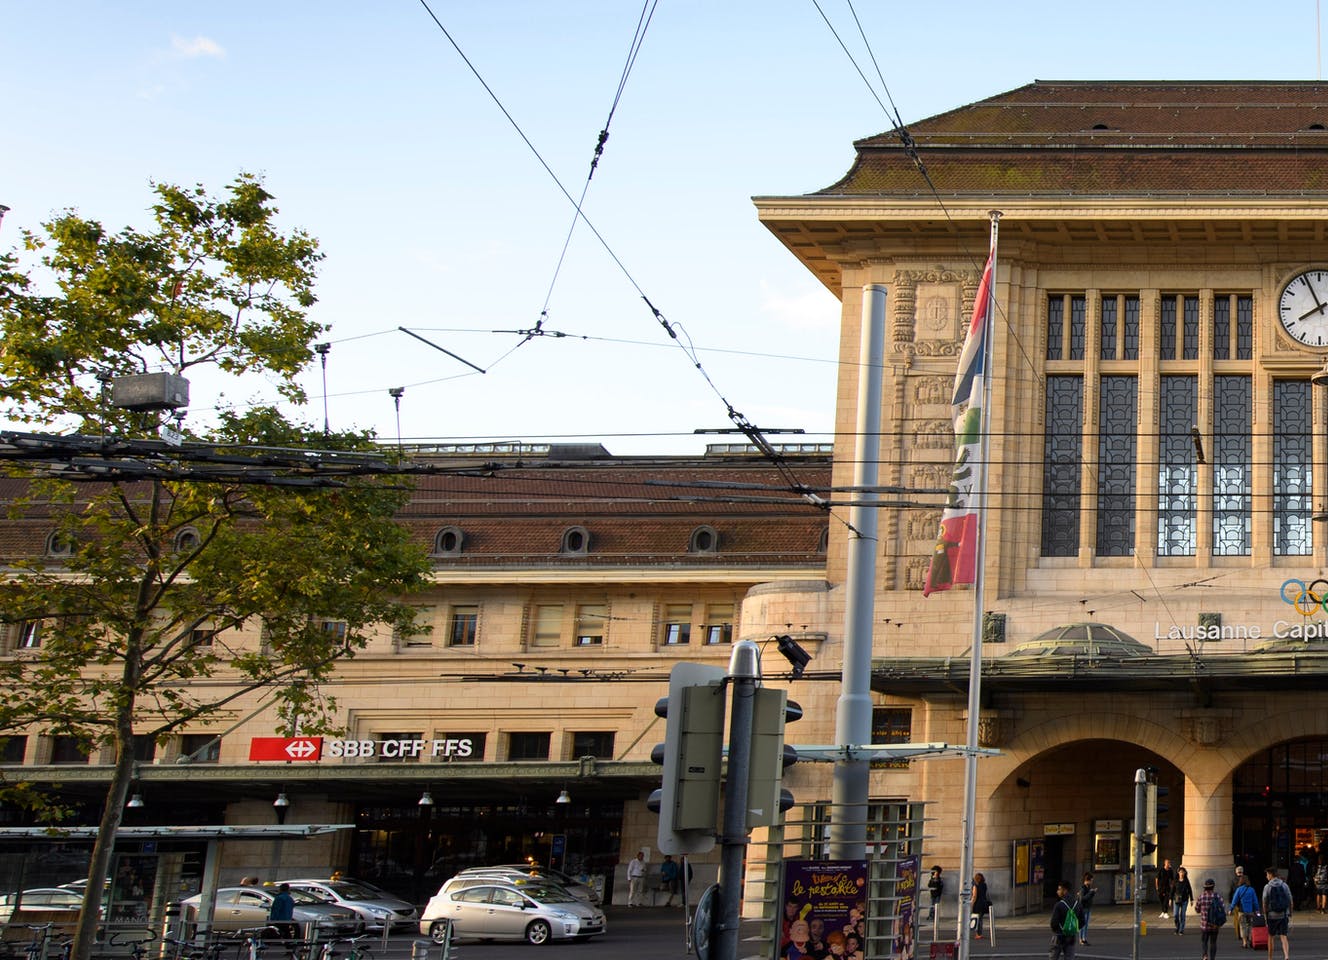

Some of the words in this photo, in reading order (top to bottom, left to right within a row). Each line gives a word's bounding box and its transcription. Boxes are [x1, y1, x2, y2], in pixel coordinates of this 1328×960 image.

[1155, 621, 1261, 640] Lausanne
[329, 740, 375, 757] SBB
[383, 739, 426, 757] CFF
[432, 738, 473, 757] FFS
[792, 879, 806, 896] le
